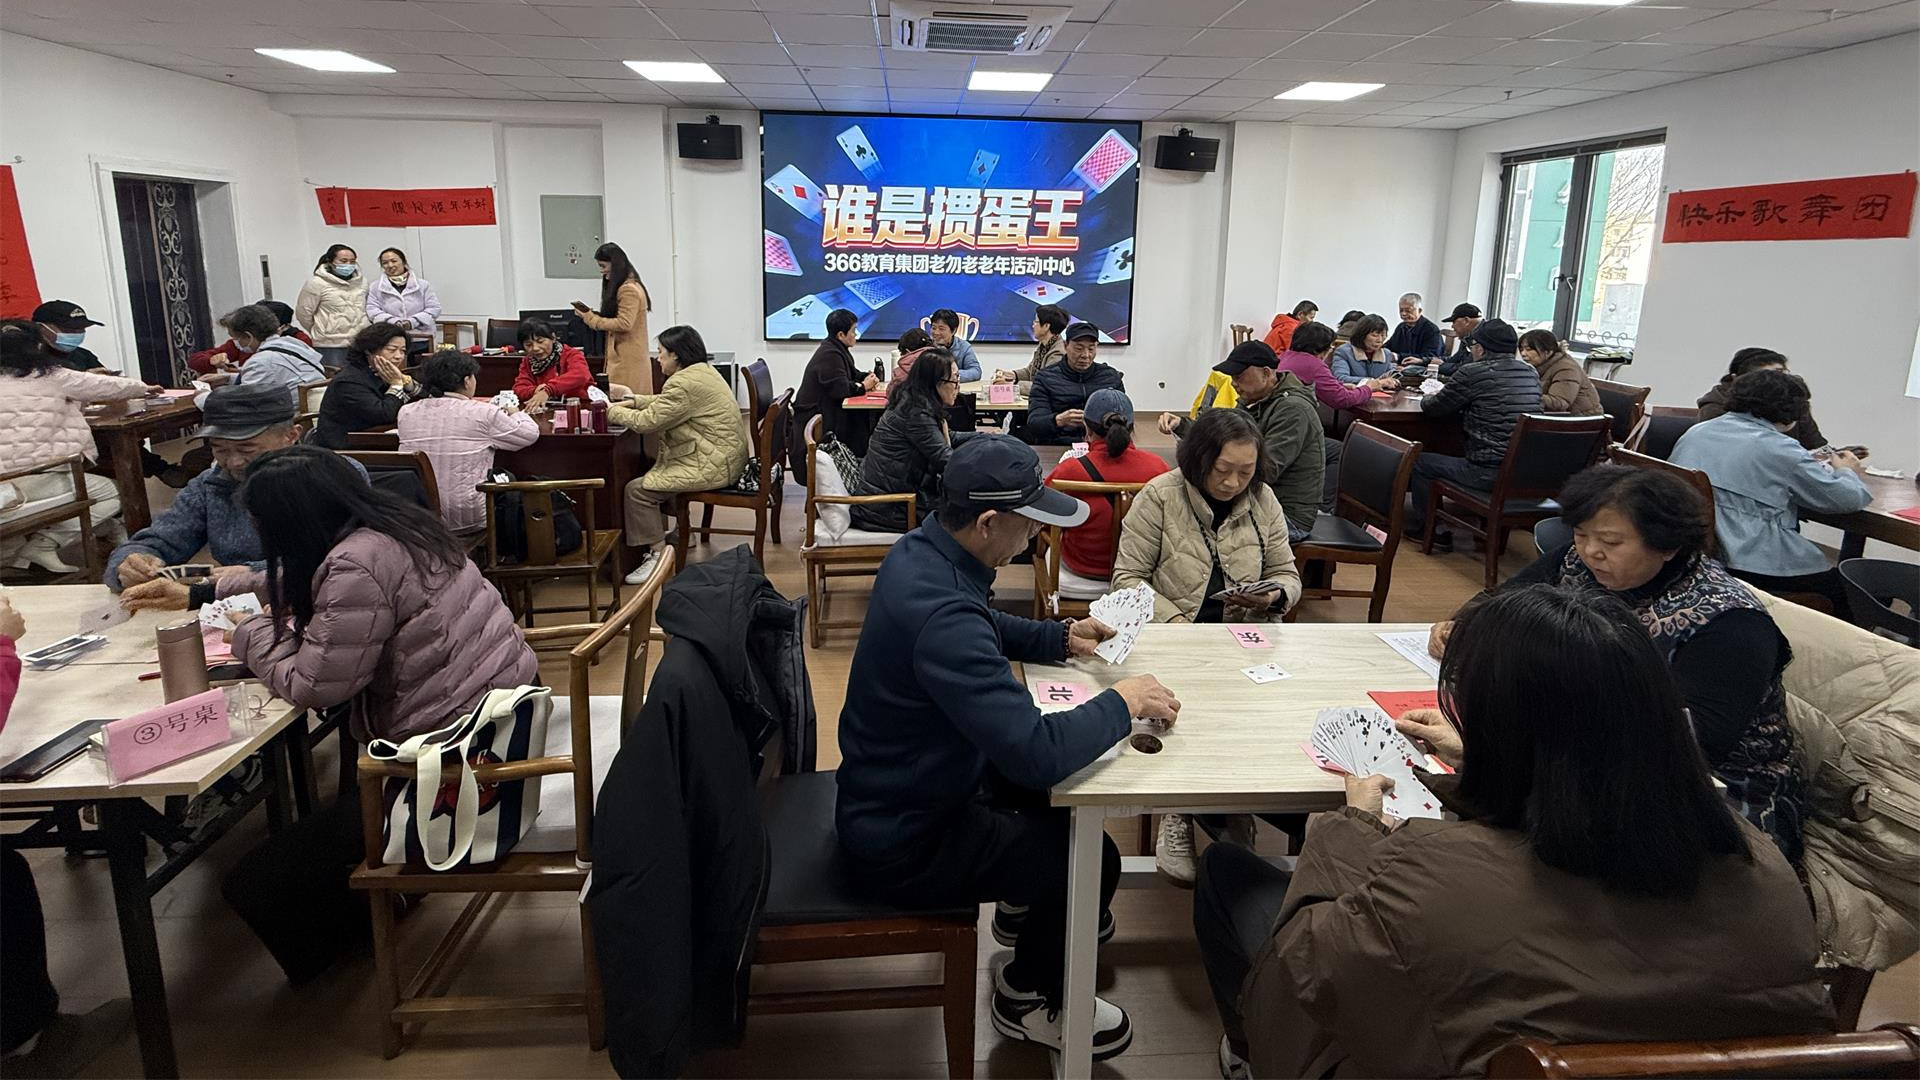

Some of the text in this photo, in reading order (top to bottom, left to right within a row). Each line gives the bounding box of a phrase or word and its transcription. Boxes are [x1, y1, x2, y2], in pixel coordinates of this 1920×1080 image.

[822, 184, 1084, 250] 谁是掼蛋王
[1677, 193, 1892, 227] 快乐歌舞团
[824, 253, 1075, 276] 366教育集团老勿老老年活动中心
[1048, 685, 1074, 701] 北
